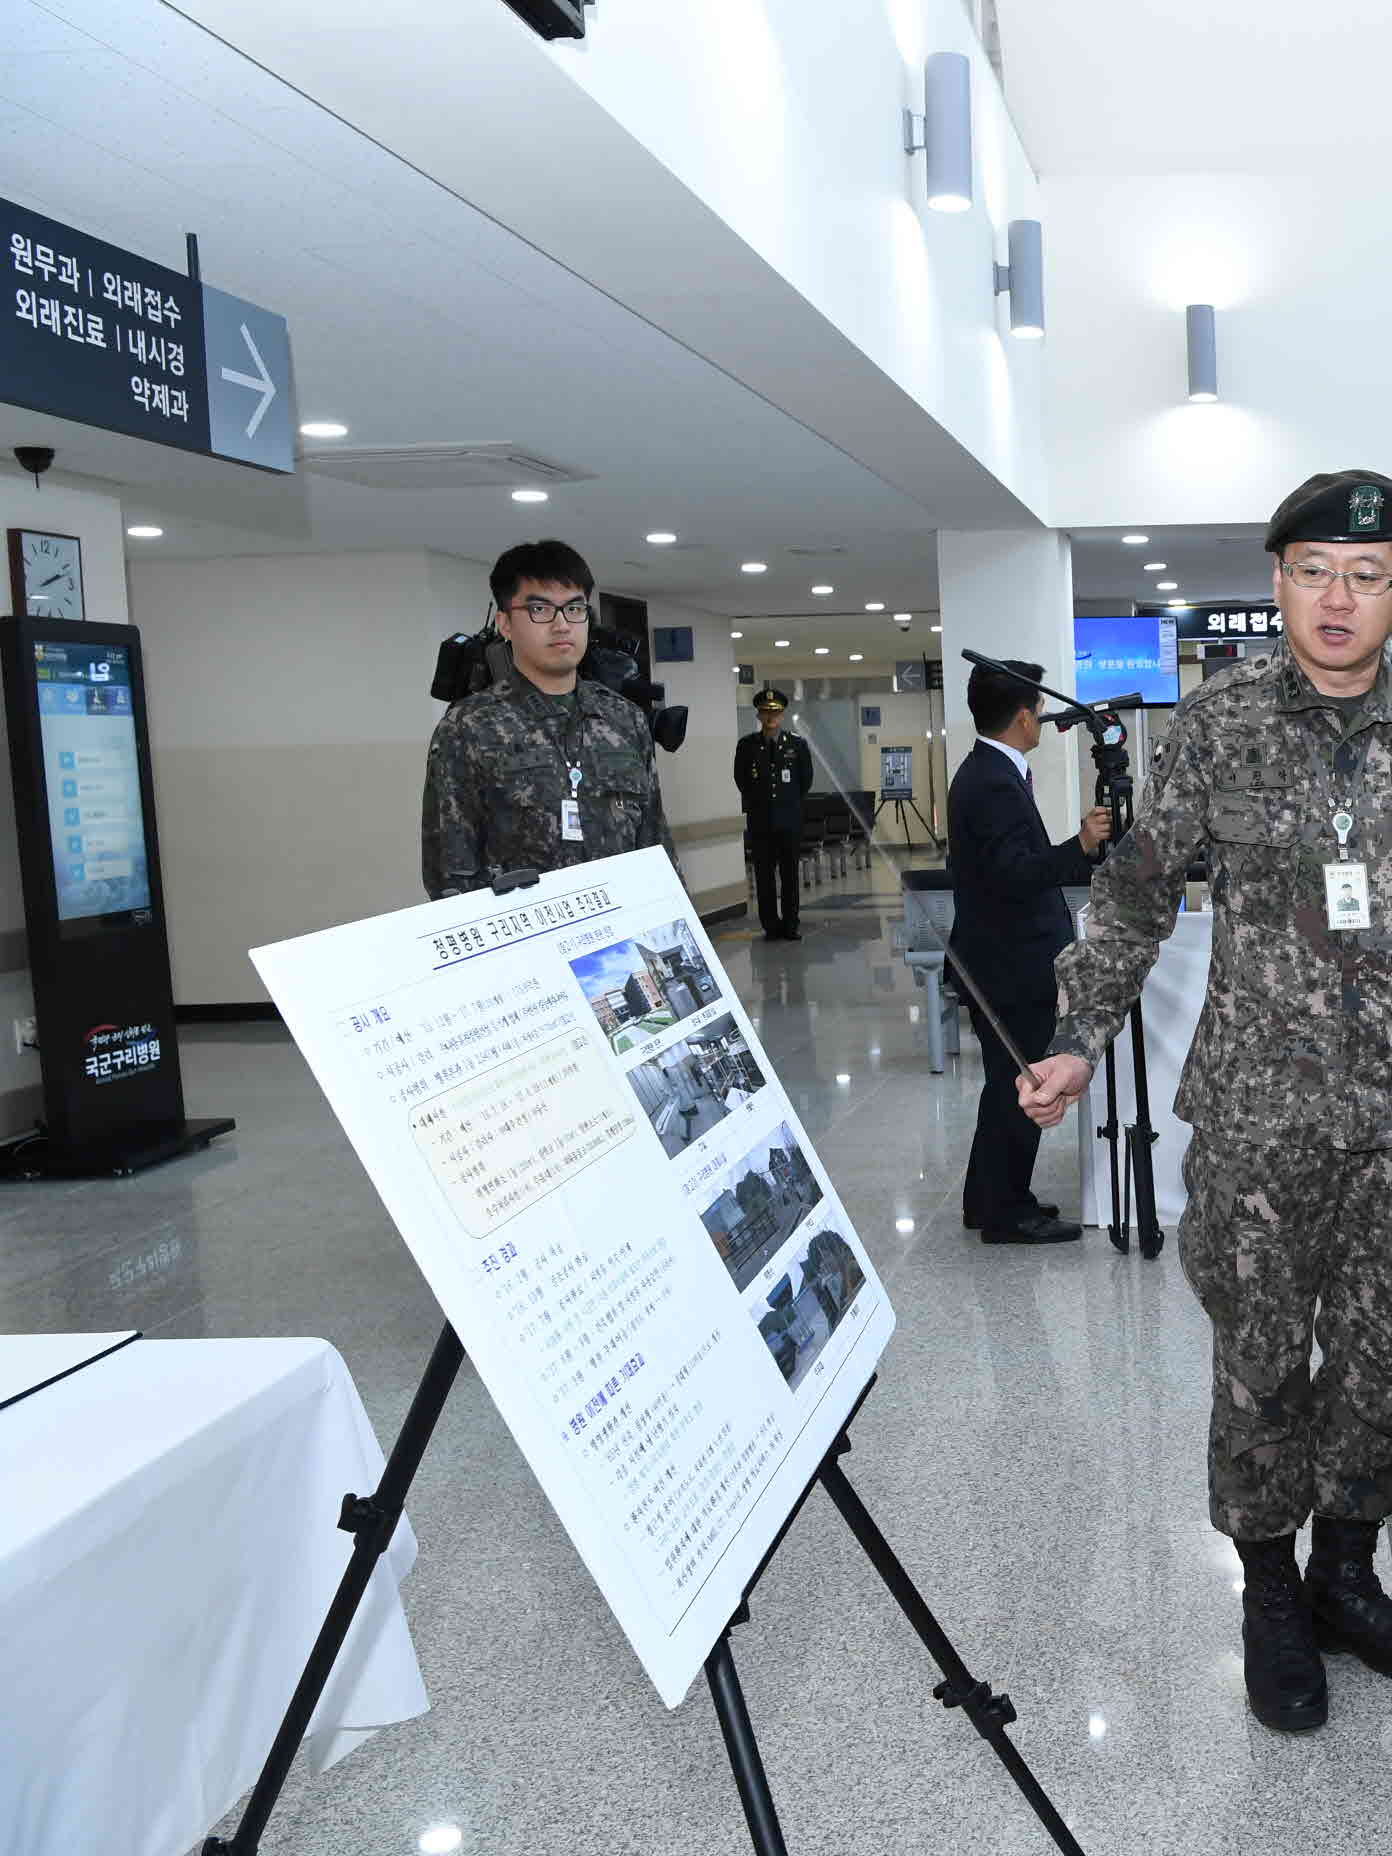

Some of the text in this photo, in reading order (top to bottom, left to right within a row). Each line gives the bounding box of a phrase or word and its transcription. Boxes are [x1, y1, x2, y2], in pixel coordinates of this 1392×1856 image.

[10, 232, 182, 329] 원무과 외래접수
[15, 288, 185, 377] 외래진료 내시경
[130, 376, 190, 423] 약제과
[40, 538, 50, 554] 12
[433, 889, 611, 959] 청평병원 구리지역 이전사업 추진결과
[85, 1040, 160, 1077] 국군구리병원
